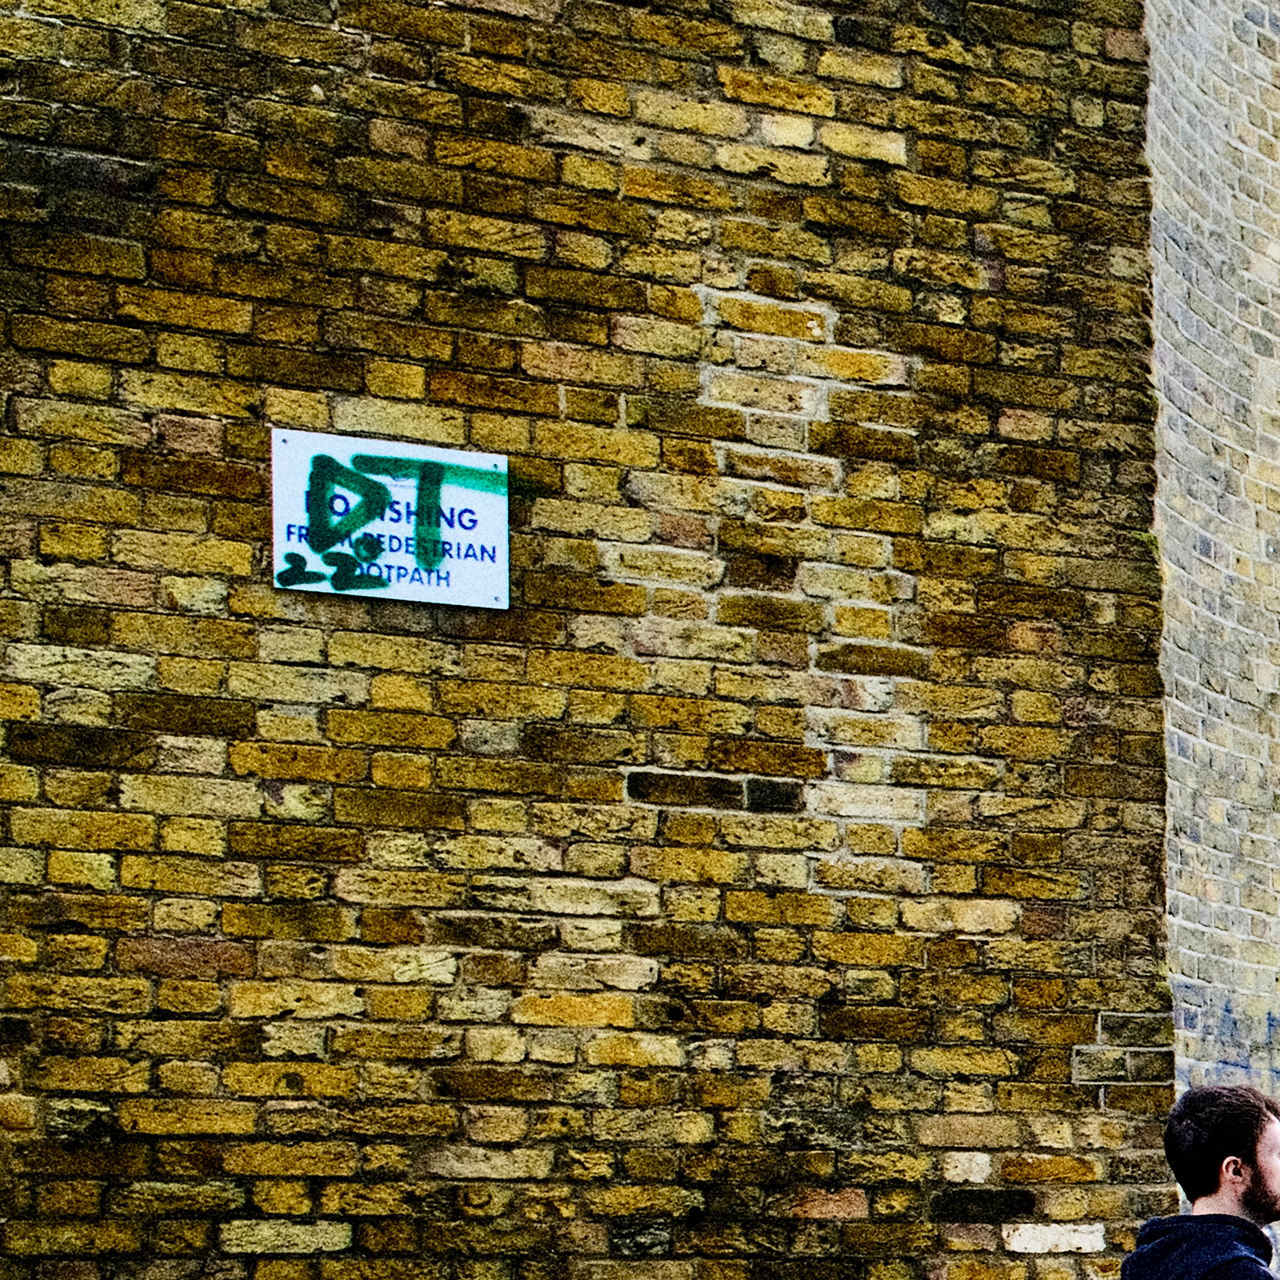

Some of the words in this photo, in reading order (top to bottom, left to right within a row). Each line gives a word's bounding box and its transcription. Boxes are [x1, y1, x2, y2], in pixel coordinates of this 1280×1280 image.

[305, 490, 350, 517] O
[368, 496, 478, 531] SHING
[286, 524, 354, 550] FR
[362, 532, 496, 563] EDETRIAN
[338, 559, 450, 588] OTPATH
